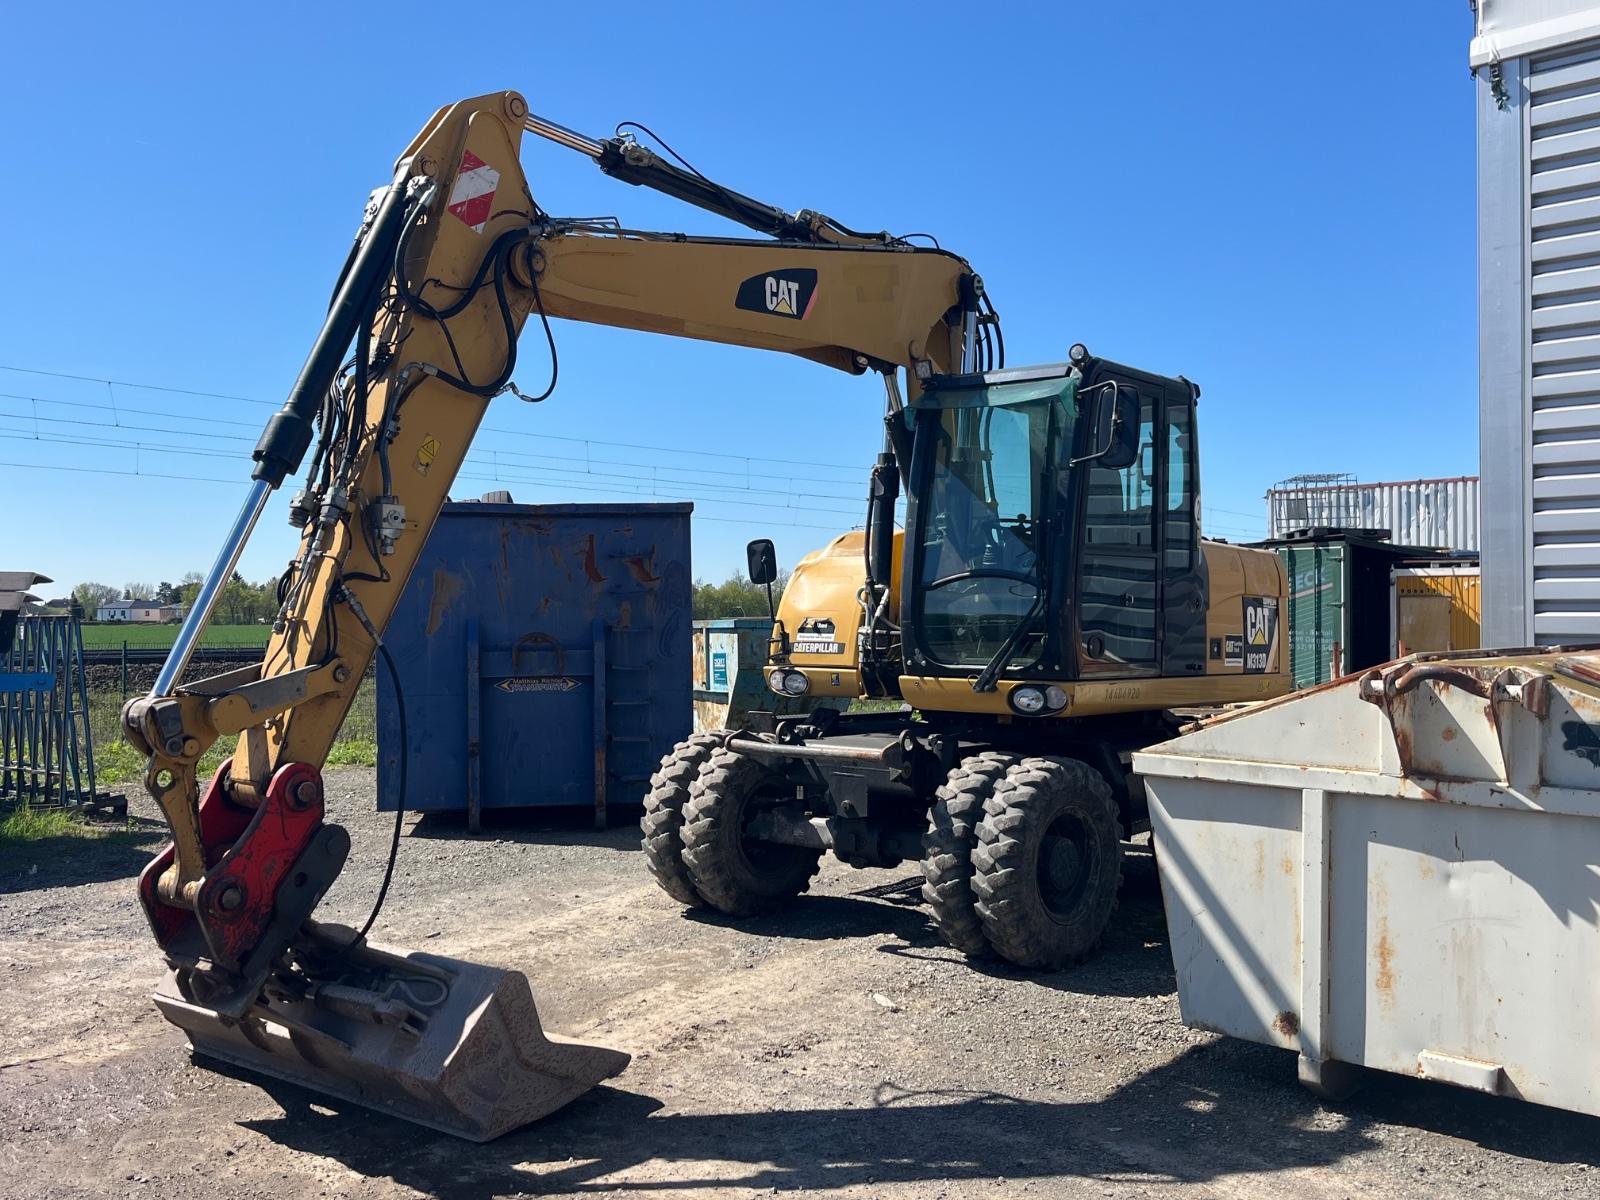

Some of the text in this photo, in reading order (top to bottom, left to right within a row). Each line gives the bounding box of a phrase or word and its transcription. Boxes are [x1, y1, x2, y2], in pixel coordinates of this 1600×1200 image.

[765, 276, 799, 315] CAT
[1246, 606, 1270, 645] CAT
[793, 642, 838, 653] CATERPILLAR
[1246, 653, 1267, 669] M313D
